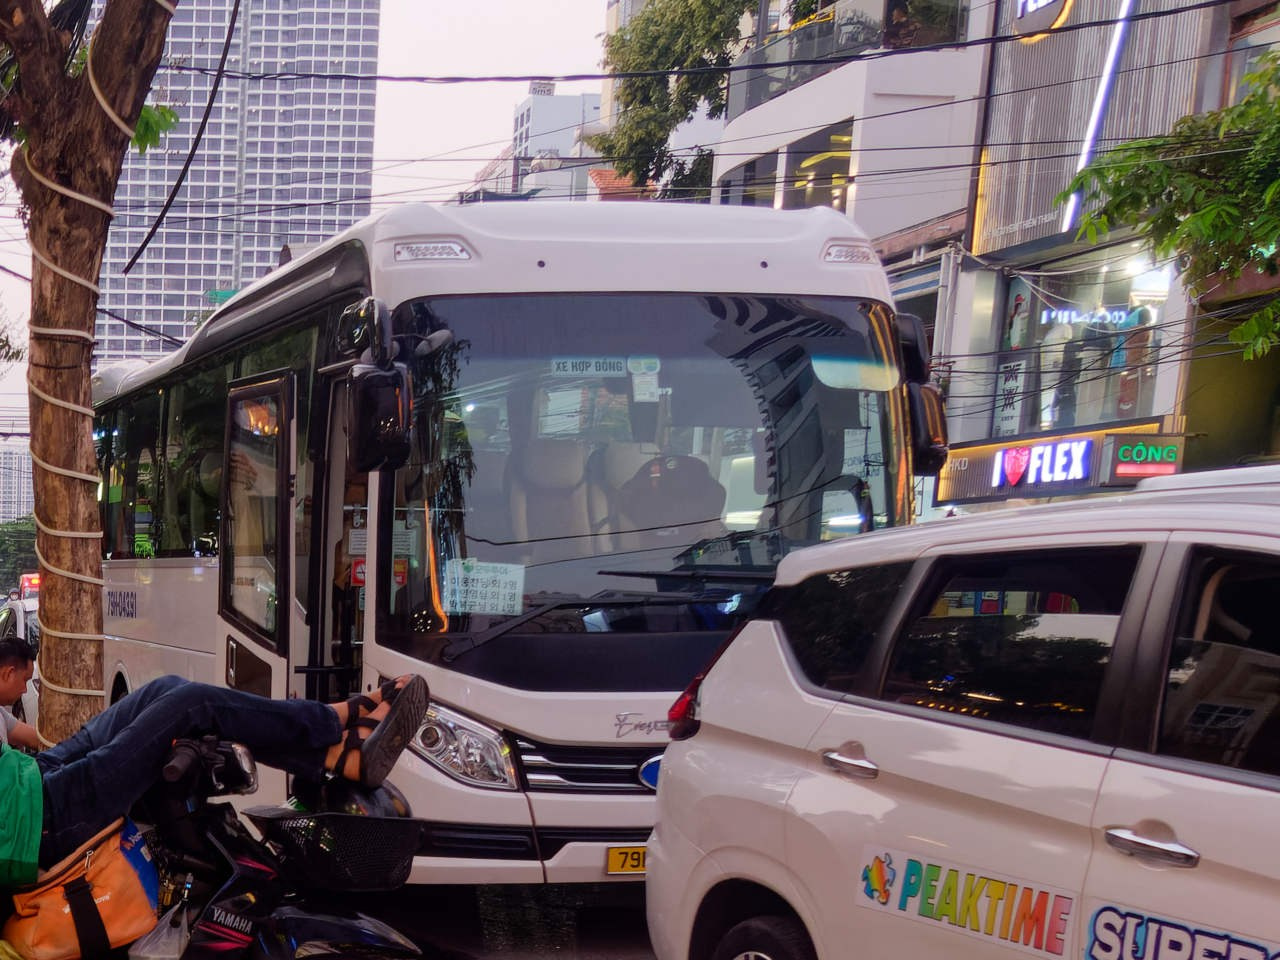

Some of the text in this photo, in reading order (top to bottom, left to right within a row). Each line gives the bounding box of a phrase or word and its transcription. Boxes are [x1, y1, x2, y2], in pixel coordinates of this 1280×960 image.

[555, 361, 568, 372] XE
[571, 361, 591, 374] HỢP
[1027, 439, 1092, 484] FLEX
[1118, 442, 1177, 463] CỘNG
[211, 905, 253, 935] YAMAHA
[898, 858, 1073, 956] PEAKTIME
